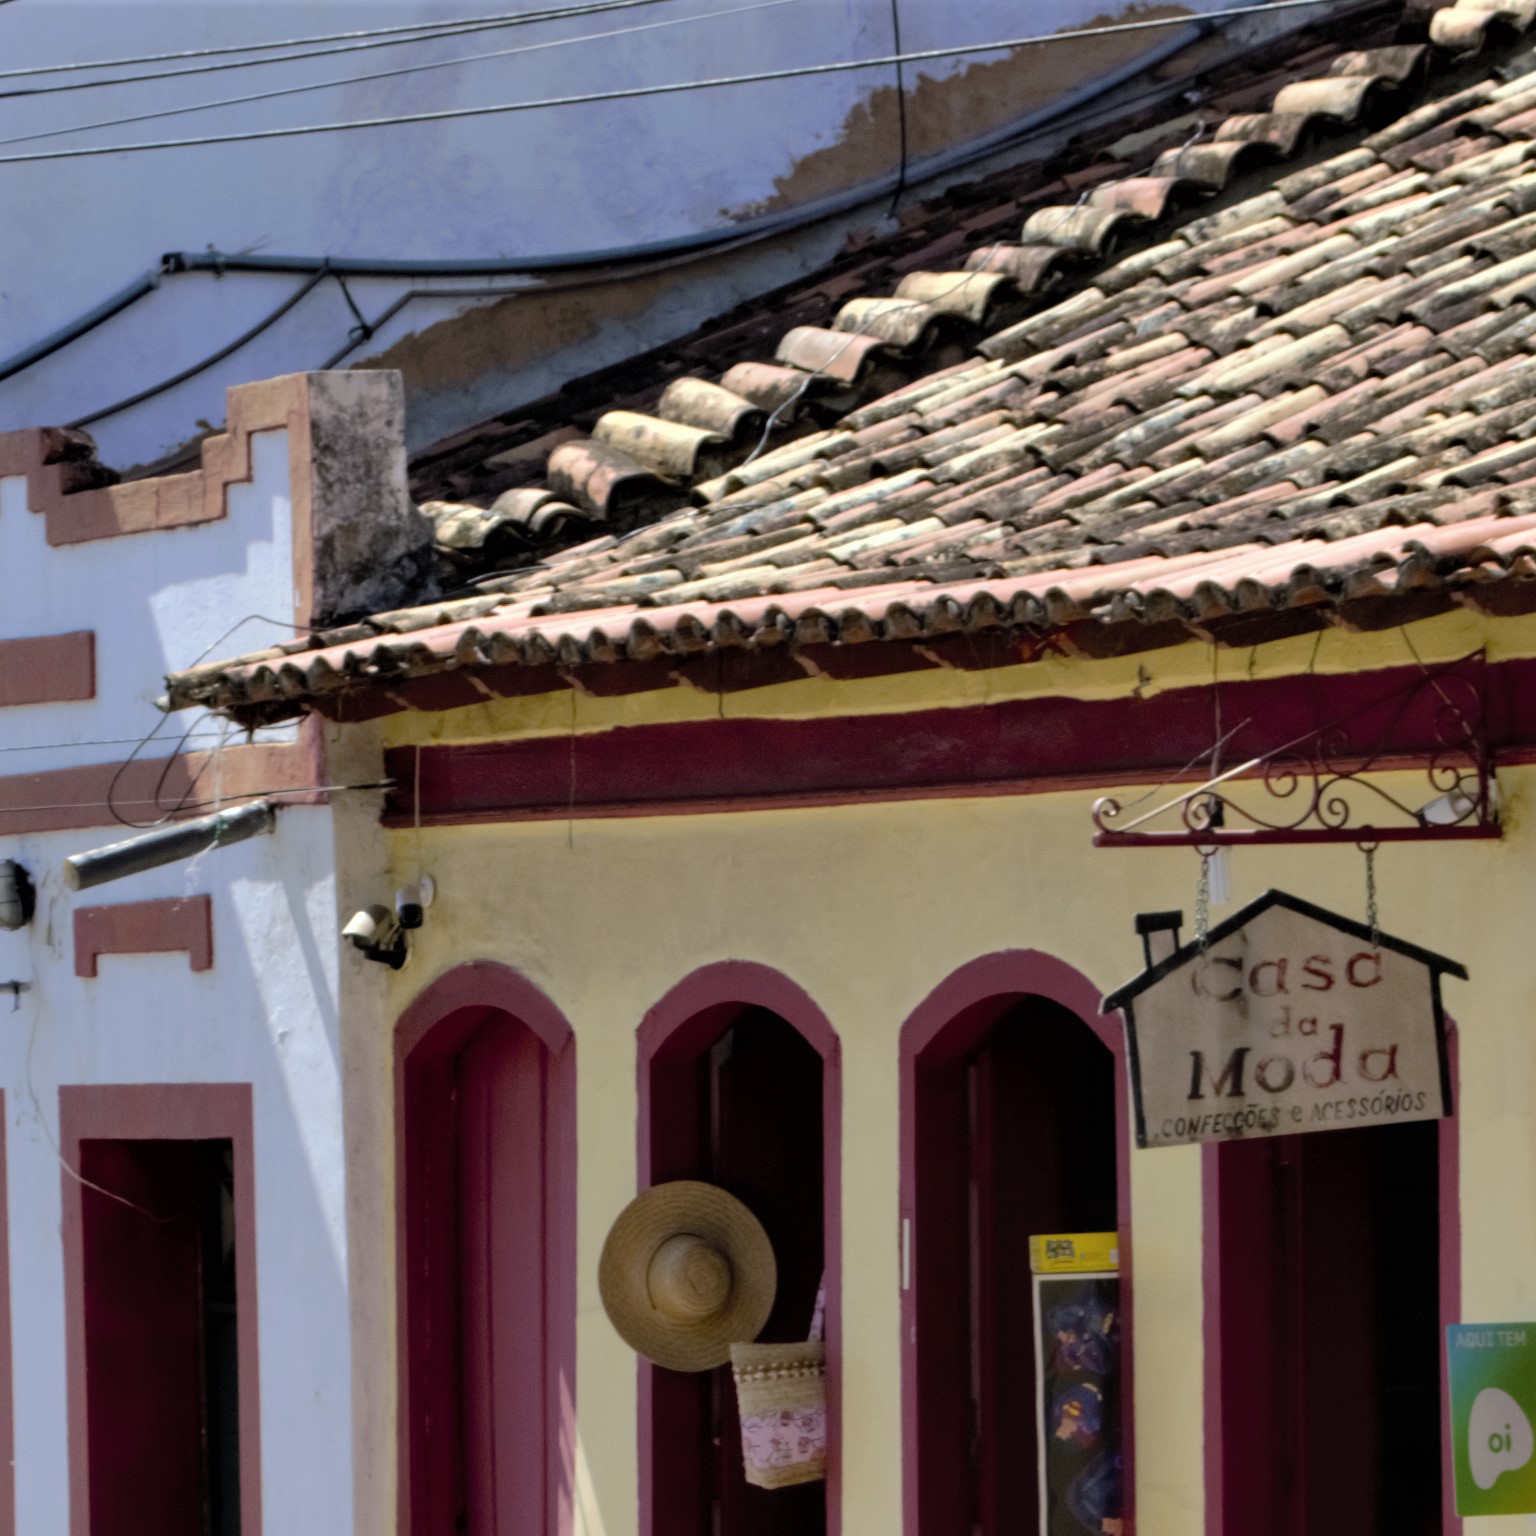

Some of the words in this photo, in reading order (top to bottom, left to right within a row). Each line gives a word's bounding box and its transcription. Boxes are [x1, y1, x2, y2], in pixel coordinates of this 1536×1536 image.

[1191, 949, 1386, 1003] Casa
[1268, 1005, 1319, 1038] da
[1186, 1022, 1401, 1101] Moda
[1454, 1331, 1494, 1349] AQUI
[1496, 1329, 1528, 1347] TEM
[1487, 1423, 1513, 1454] oi
